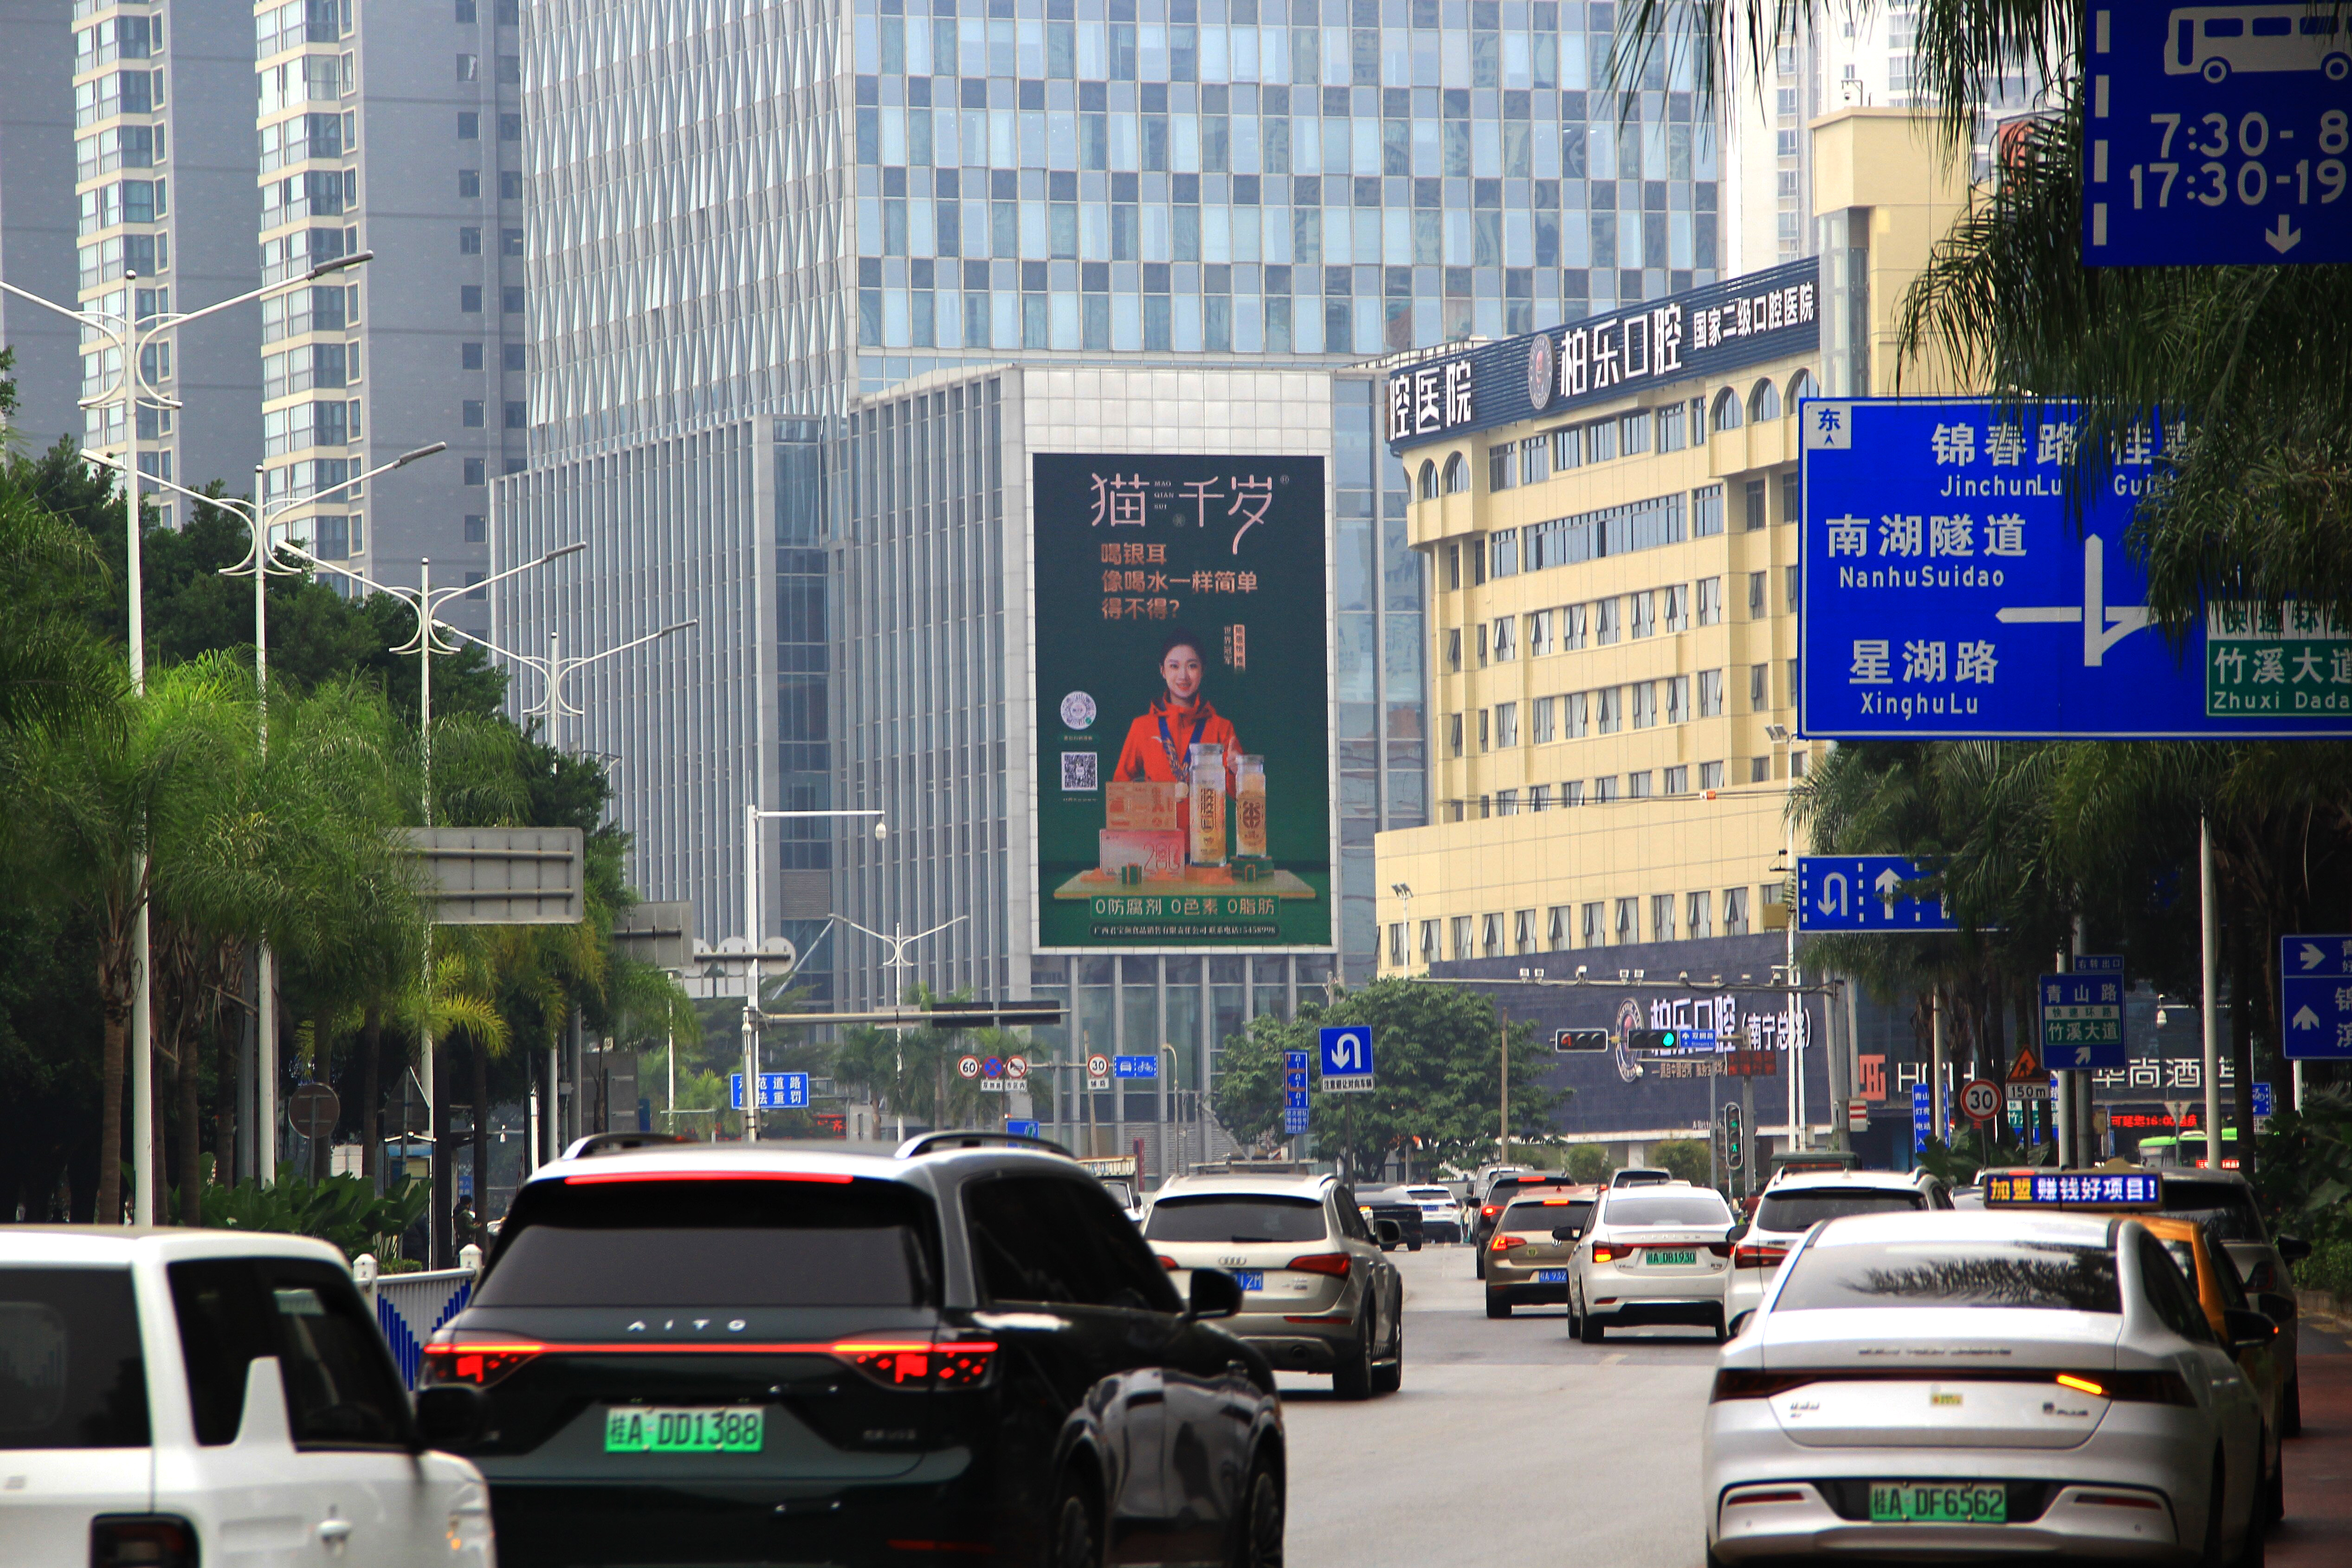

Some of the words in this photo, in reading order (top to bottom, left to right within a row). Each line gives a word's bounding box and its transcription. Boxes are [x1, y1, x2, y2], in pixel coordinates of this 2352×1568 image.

[1560, 303, 1682, 397] 柏乐口腔
[1693, 281, 1814, 350] 国家二级口腔医院
[1817, 408, 1841, 431] 东
[1931, 421, 2077, 466] 锦春路
[1826, 513, 2028, 558] 南湖隧道
[1101, 543, 1166, 565] 喝银耳
[1102, 571, 1258, 594] 像喝水一样简单
[1849, 639, 1999, 685] 星湖路
[2214, 690, 2280, 710] Zhuxi
[2078, 958, 2120, 969] 右转出口
[2046, 983, 2117, 1004] 青山路
[2048, 1021, 2118, 1041] 竹溪大道
[963, 1061, 976, 1073] 60
[1092, 1060, 1105, 1071] 30
[1970, 1091, 1994, 1110] 30
[2011, 1086, 2046, 1098] 150m
[1990, 1177, 2033, 1202] 加盟
[627, 1318, 747, 1333] AITO
